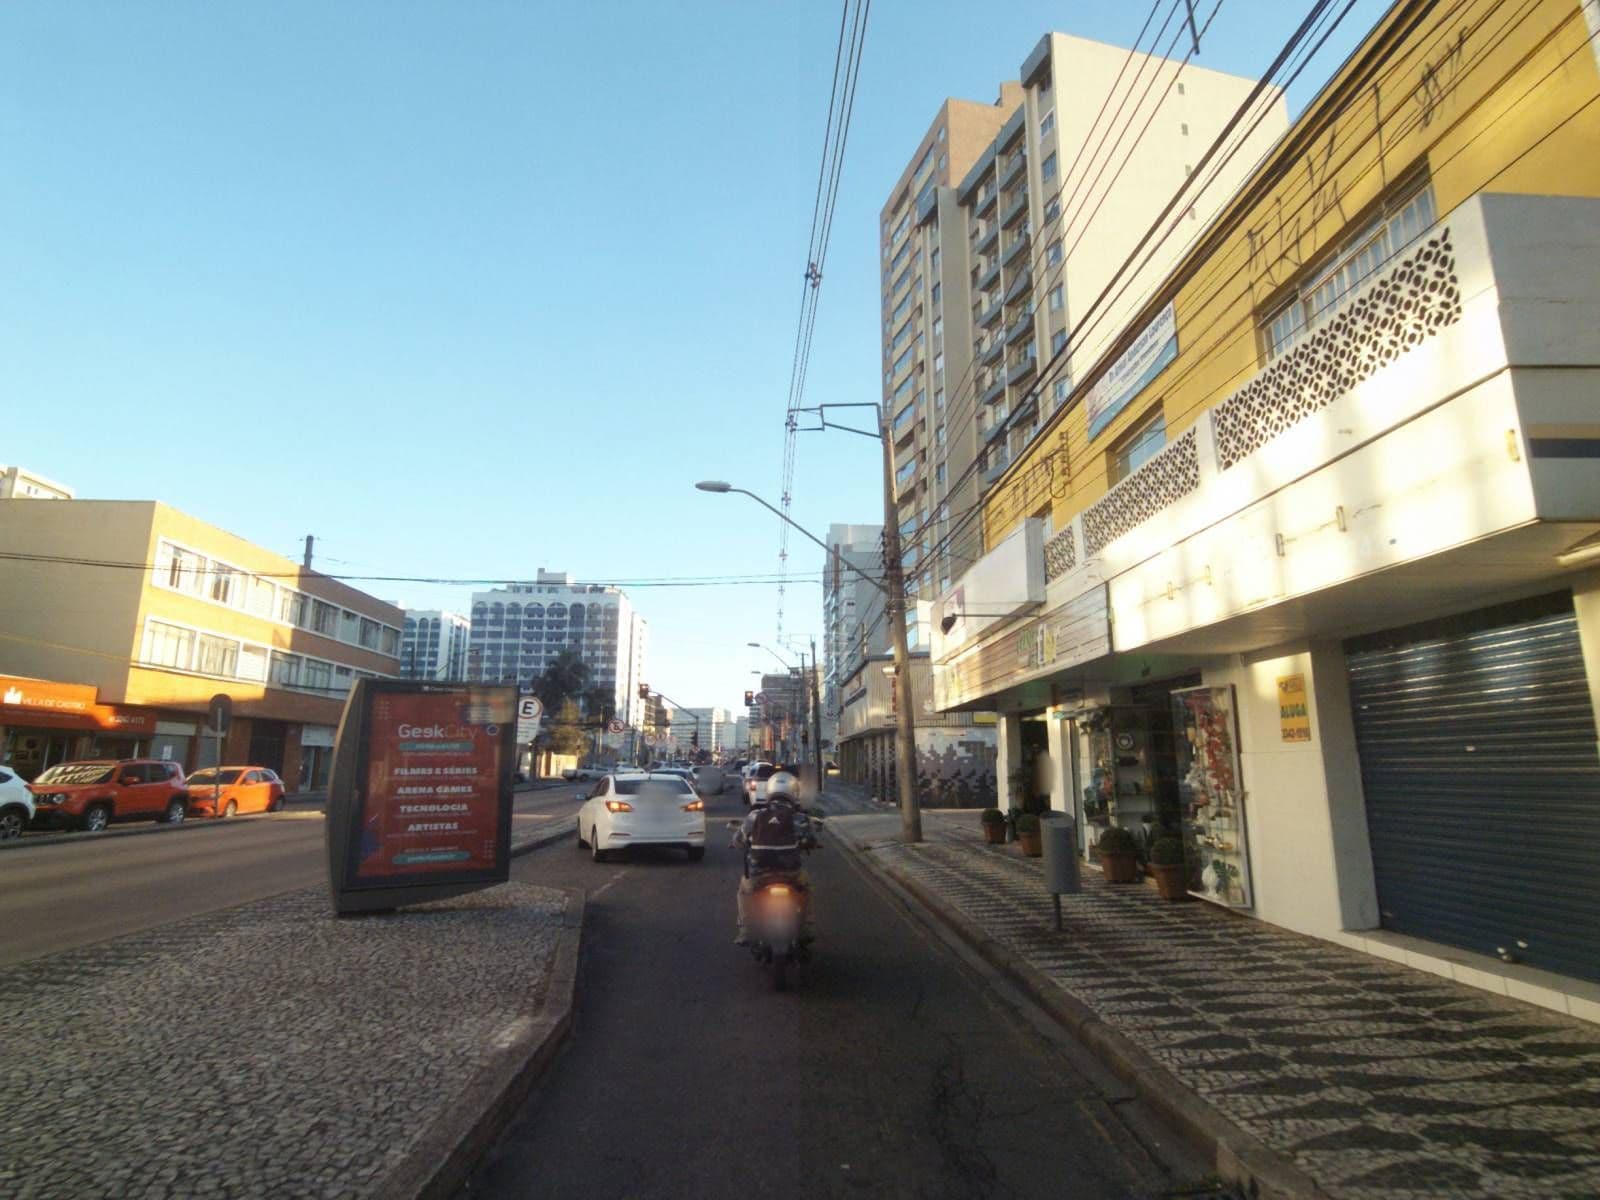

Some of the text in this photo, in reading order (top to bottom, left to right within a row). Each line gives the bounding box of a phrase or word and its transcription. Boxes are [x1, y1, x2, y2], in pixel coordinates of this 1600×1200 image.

[522, 701, 535, 715] E
[394, 768, 432, 776] FILMES
[397, 785, 473, 795] ARENA GAMES
[400, 804, 468, 813] TECNOLOGIA
[407, 822, 459, 832] ARTISTAS
